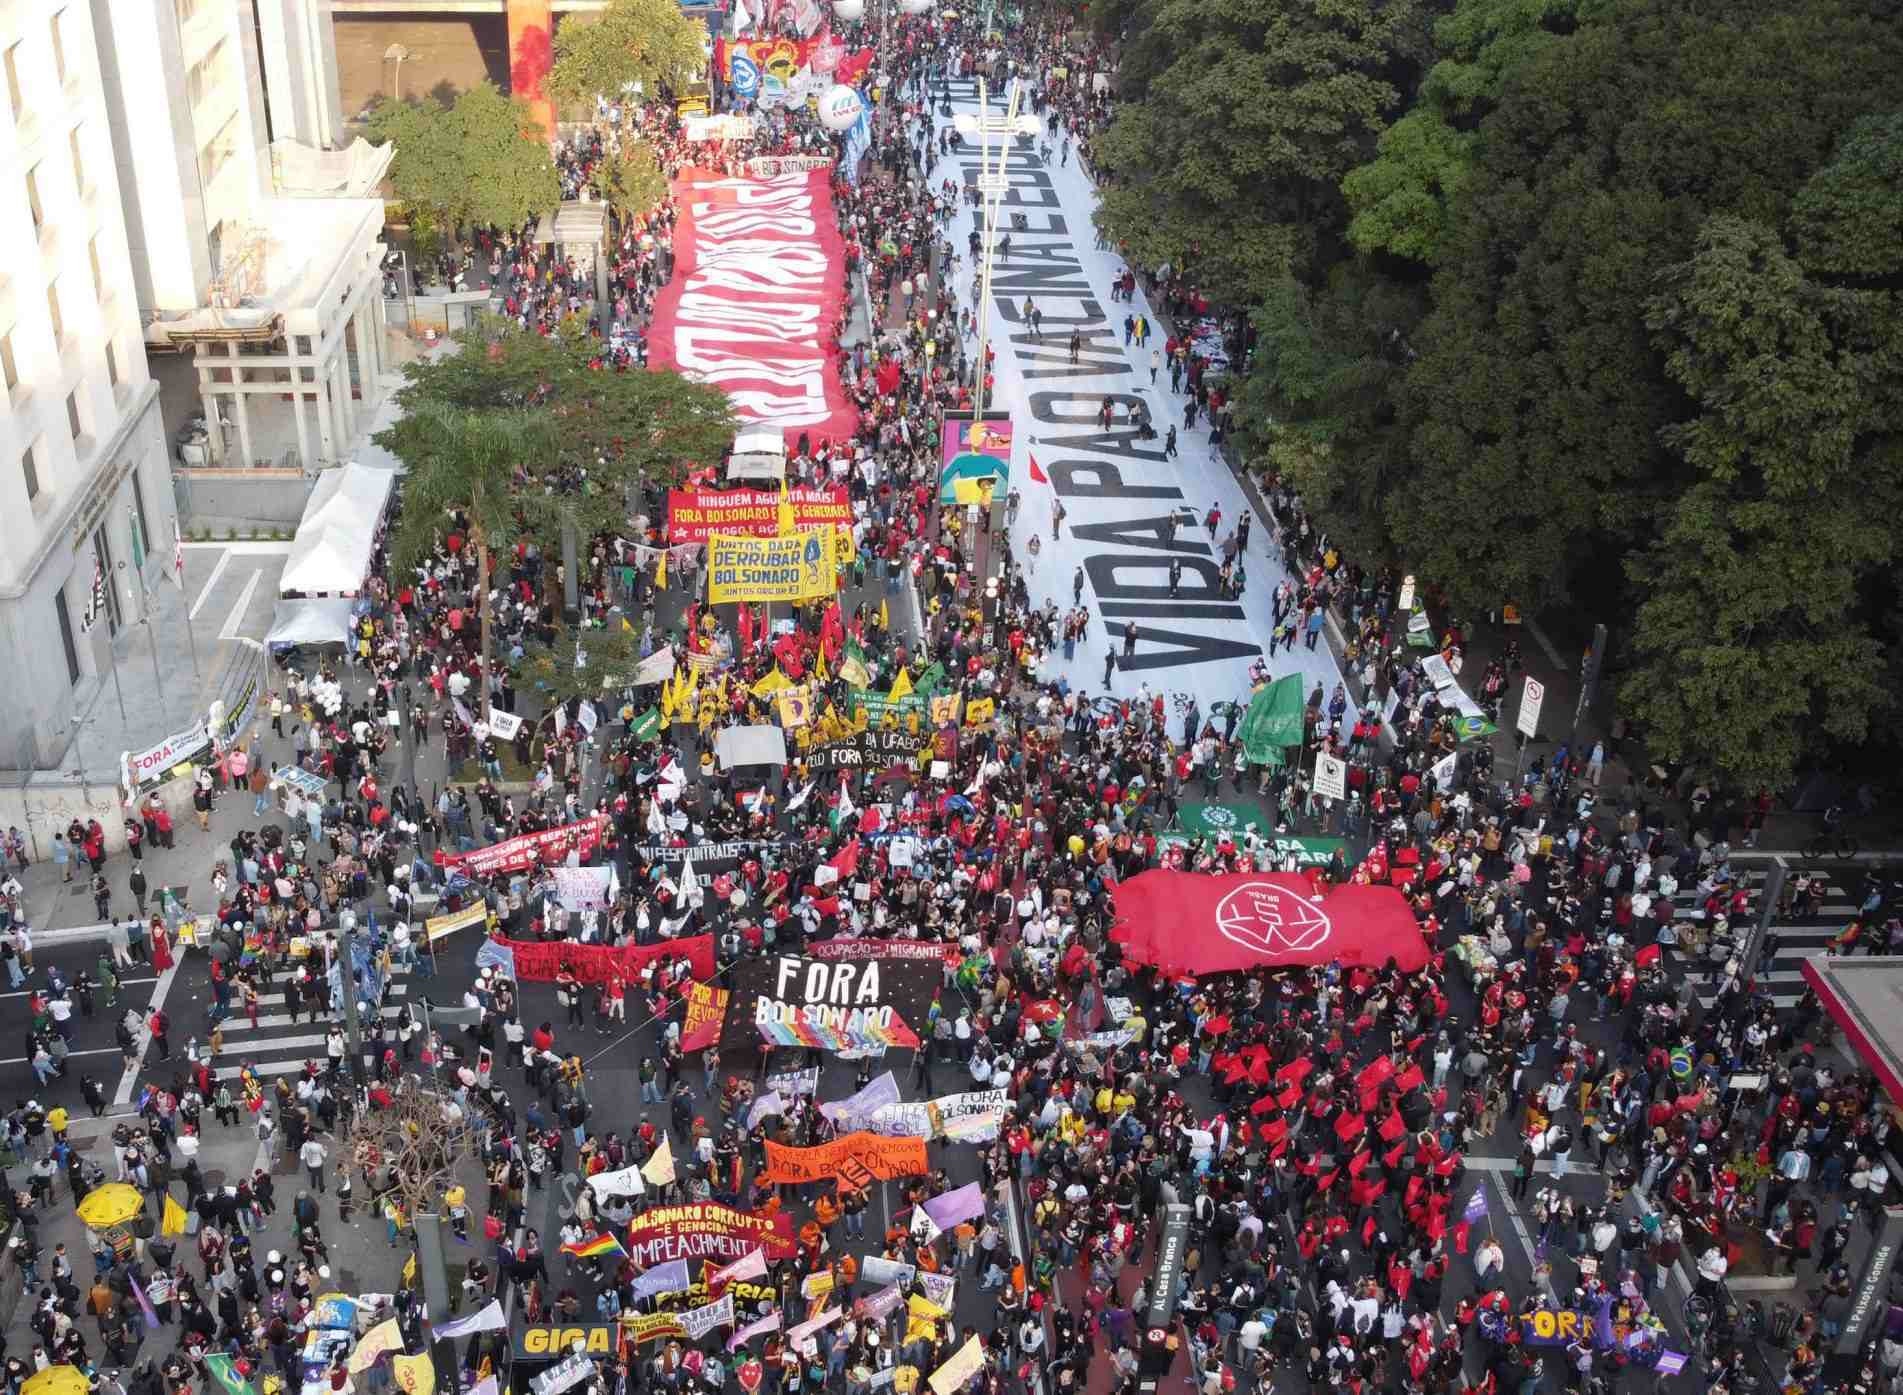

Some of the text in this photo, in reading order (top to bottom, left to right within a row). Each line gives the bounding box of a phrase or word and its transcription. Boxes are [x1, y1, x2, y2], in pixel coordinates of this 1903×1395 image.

[988, 242, 1134, 379] VACINA
[674, 508, 703, 523] FORA
[706, 505, 769, 523] BOLSONARO
[714, 550, 801, 567] DERRUBAR
[714, 568, 800, 585] BOLSONARO
[1069, 506, 1263, 671] VIDA,
[831, 748, 863, 765] FORA
[777, 957, 880, 1005] FORA
[756, 995, 894, 1034] BOLSONARO
[631, 1205, 775, 1232] BOLSONARO CORRUPTO
[631, 1234, 749, 1265] IMPEACHMENT
[1160, 1236, 1177, 1272] Branca
[1156, 1273, 1170, 1297] Casa
[524, 1328, 609, 1353] GIGA
